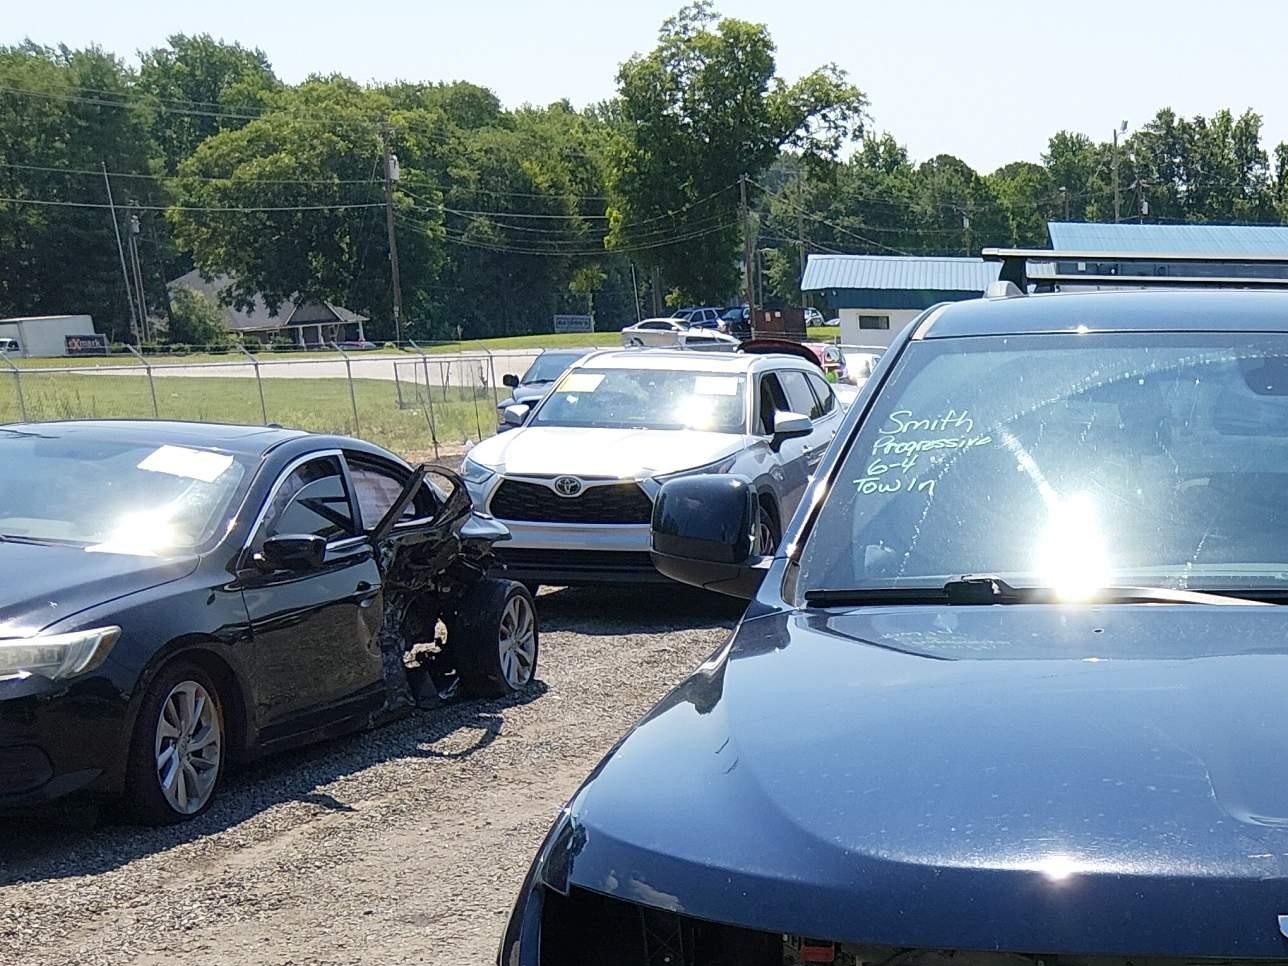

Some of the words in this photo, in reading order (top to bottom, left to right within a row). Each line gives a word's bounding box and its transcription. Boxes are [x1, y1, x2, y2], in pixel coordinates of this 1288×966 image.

[879, 410, 973, 434] Smith
[872, 435, 993, 457] Progressive
[867, 456, 919, 475] 6-4
[853, 478, 901, 494] Tow
